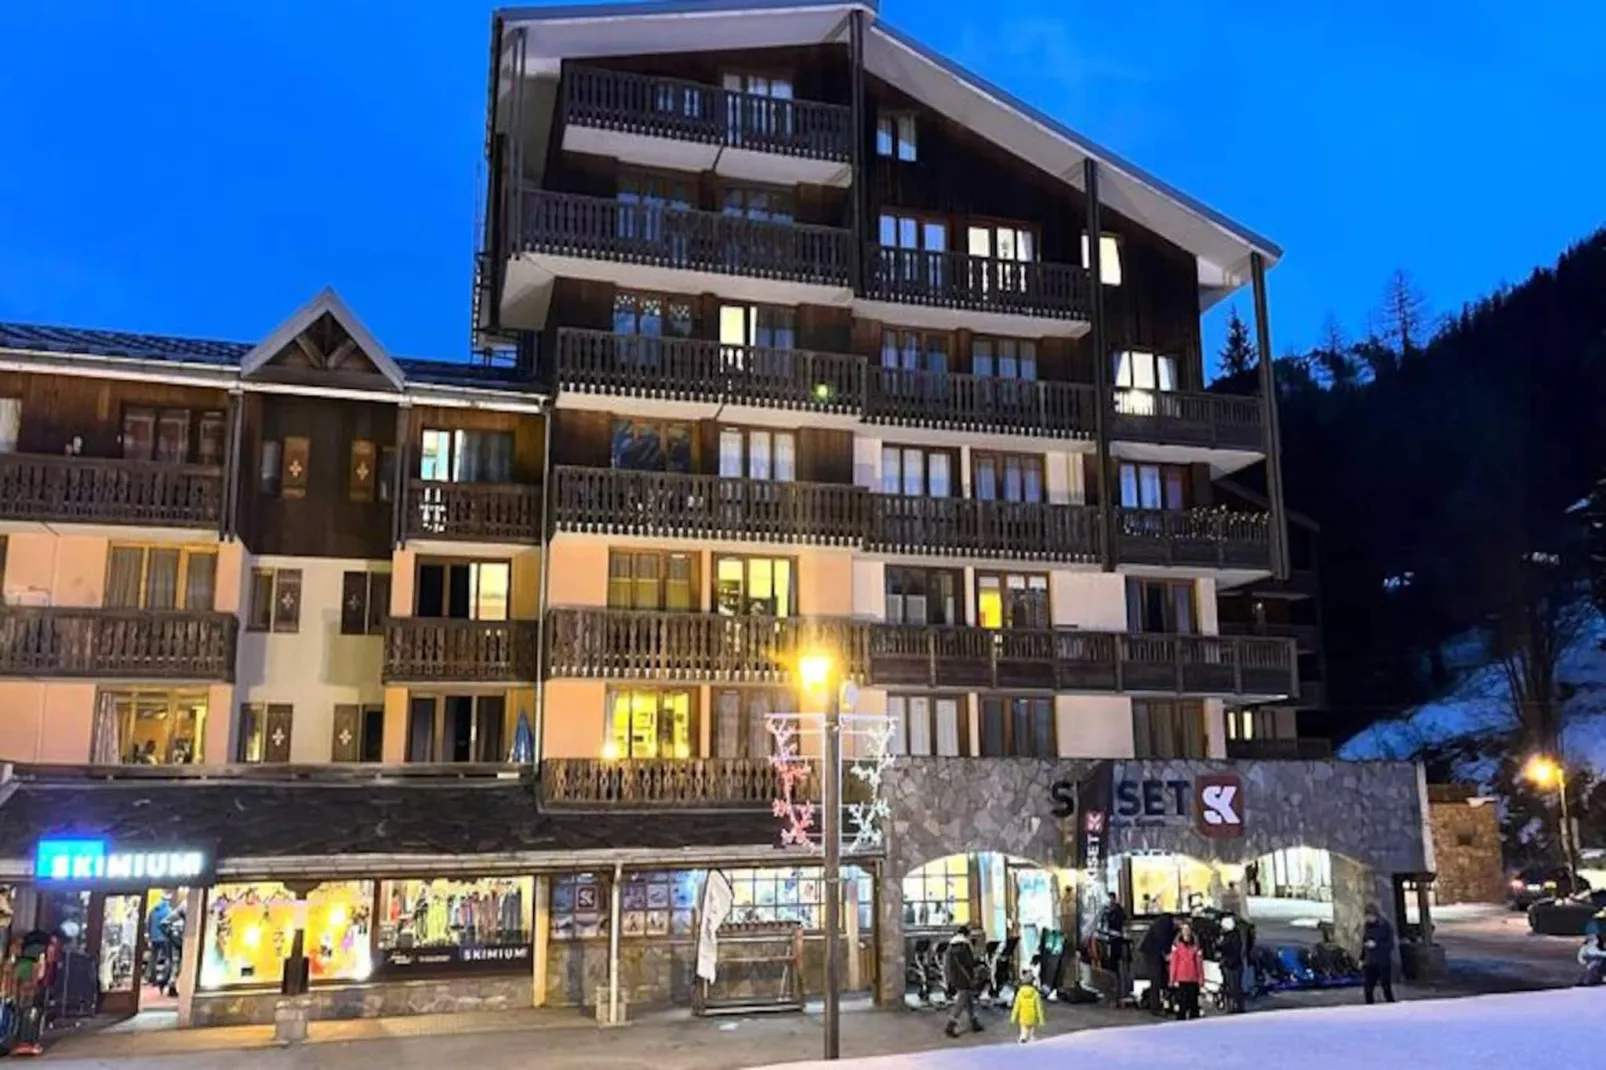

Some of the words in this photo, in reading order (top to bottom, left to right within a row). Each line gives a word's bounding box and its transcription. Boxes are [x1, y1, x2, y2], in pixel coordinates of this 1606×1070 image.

[1051, 780, 1189, 817] SSET
[52, 852, 203, 880] SKIMIUM
[463, 947, 528, 961] SKIMIUM
